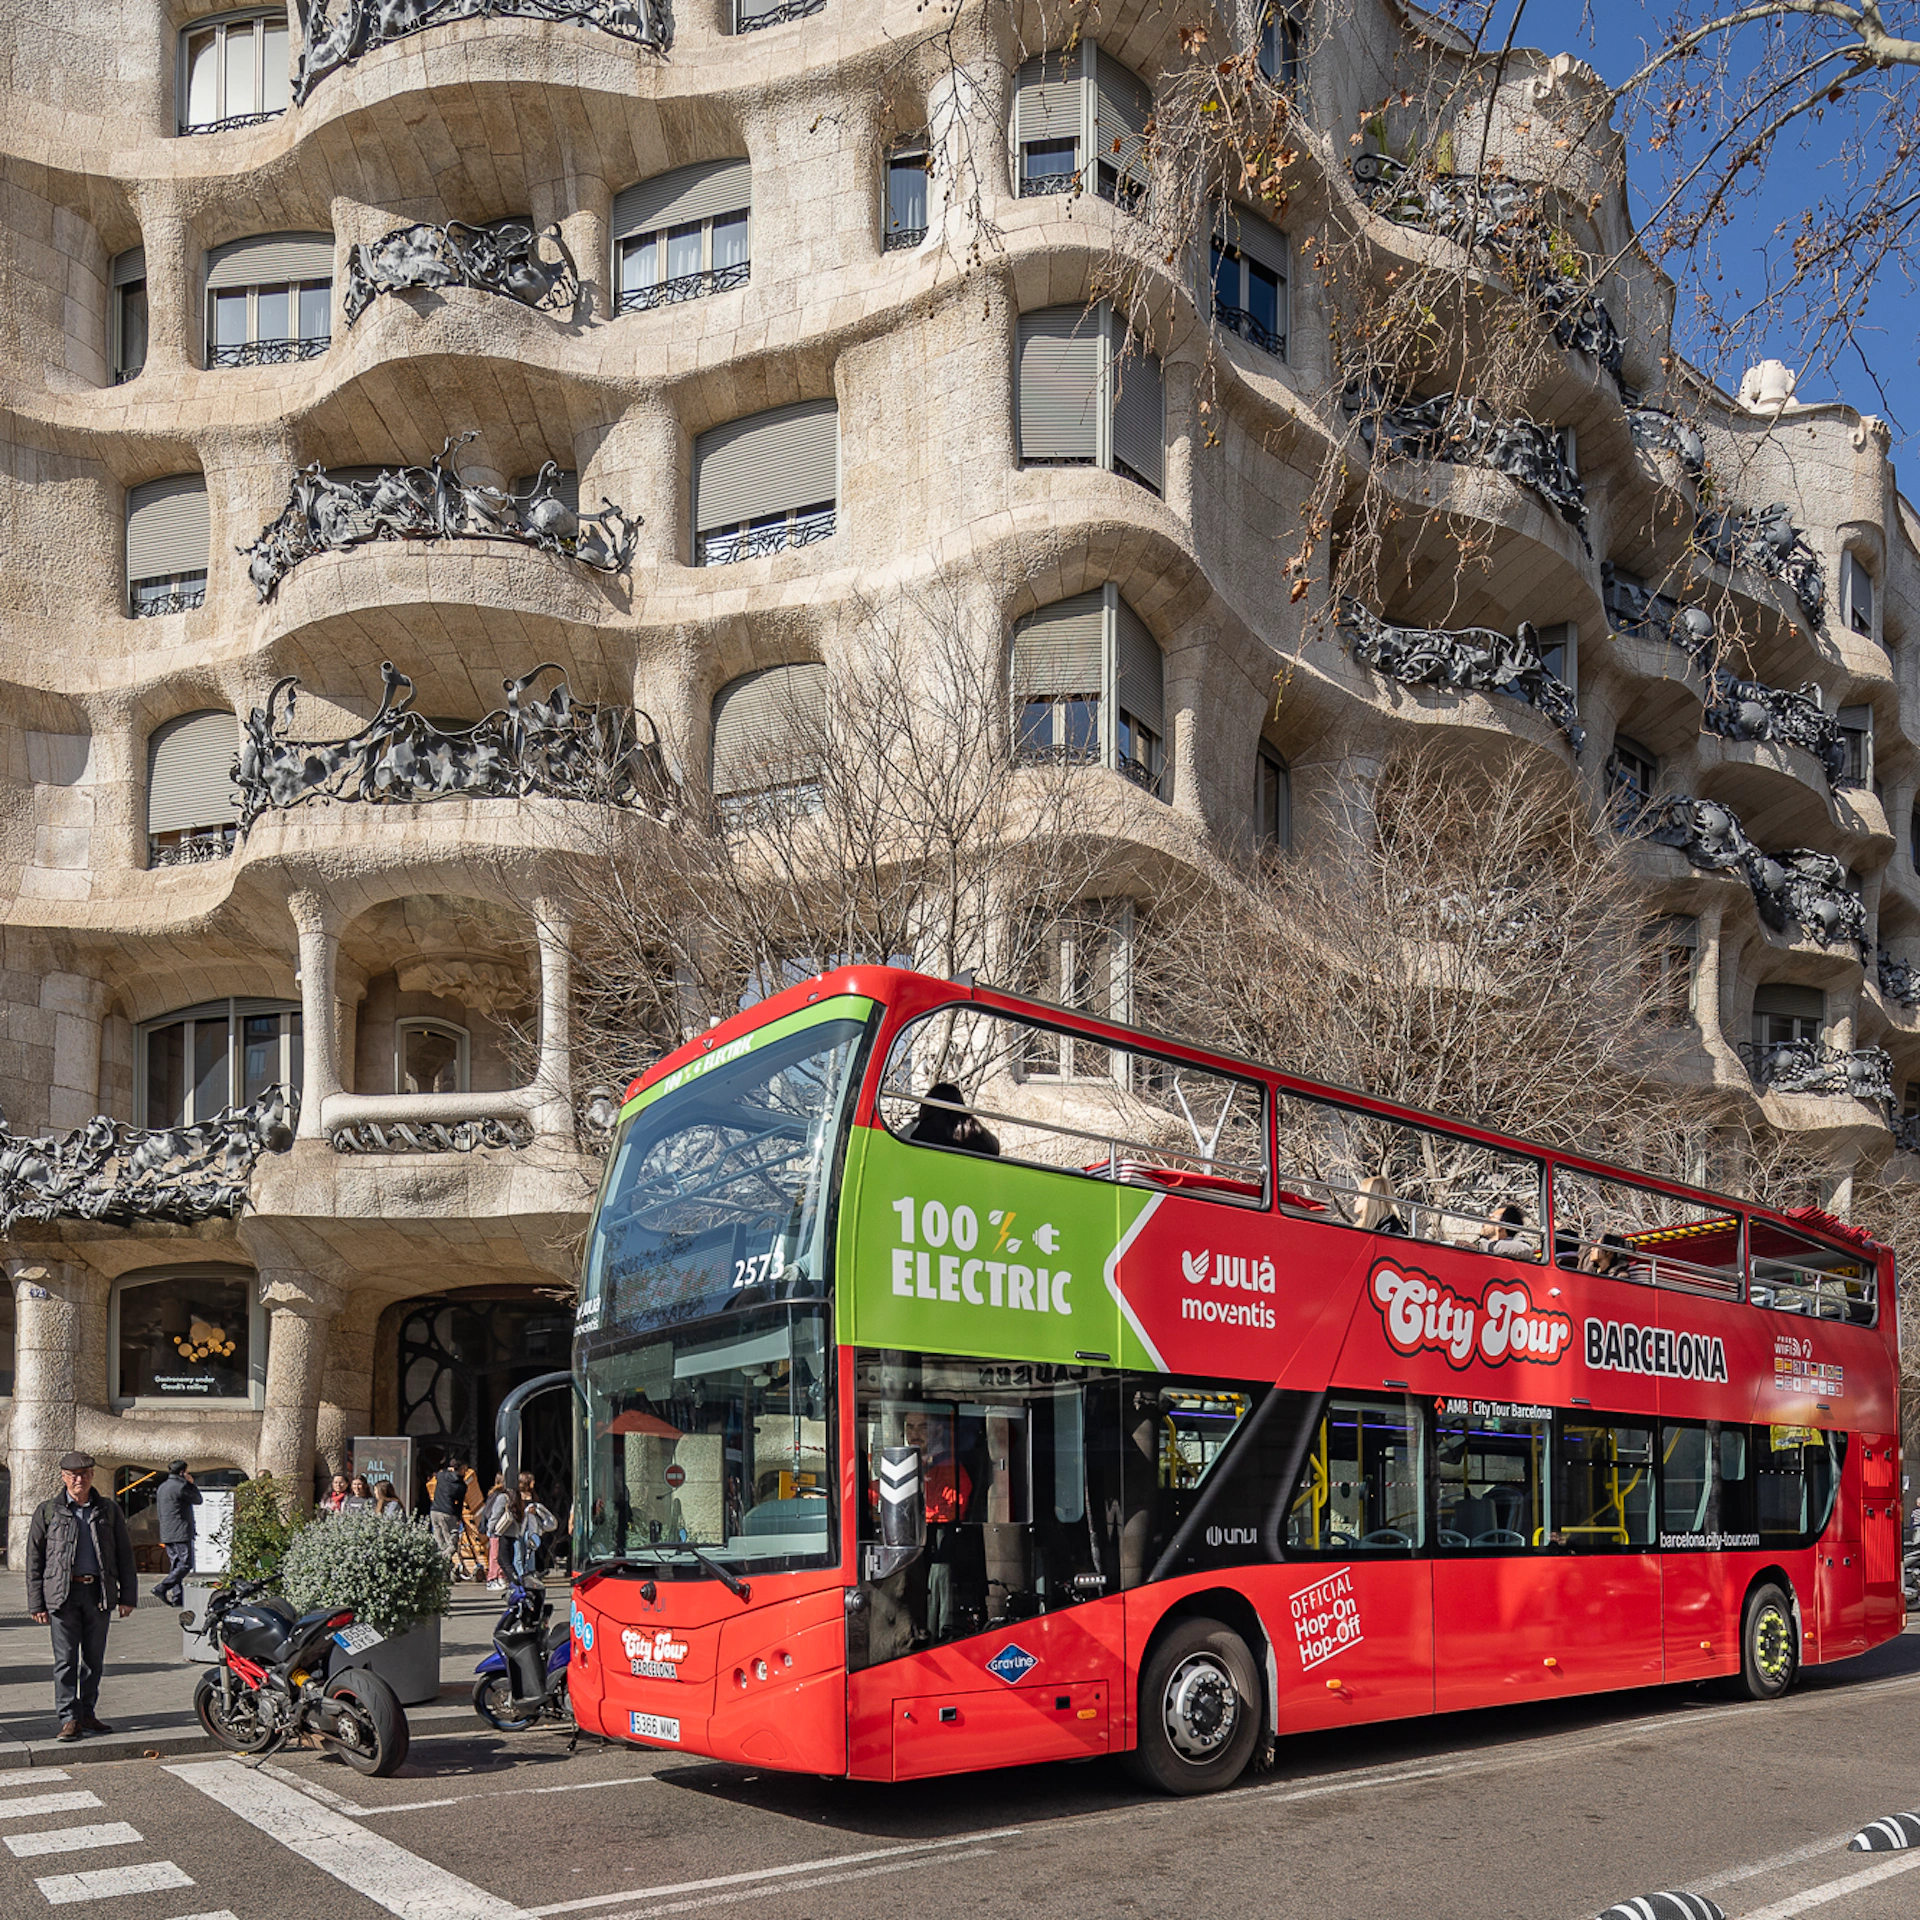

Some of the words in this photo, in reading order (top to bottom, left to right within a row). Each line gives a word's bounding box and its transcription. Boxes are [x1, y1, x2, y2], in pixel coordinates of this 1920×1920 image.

[892, 1196, 979, 1252] 100
[732, 1252, 785, 1289] 2573
[892, 1248, 1072, 1316] ELECTRIC
[1181, 1297, 1276, 1330] moventis
[1374, 1269, 1474, 1360] City
[1481, 1289, 1568, 1357] Tour
[1584, 1317, 1729, 1384] BARCELONA
[187, 1383, 208, 1392] ceiling
[195, 1375, 215, 1383] under
[1447, 1399, 1468, 1414] AMB
[1473, 1401, 1490, 1418] City
[1491, 1402, 1510, 1416] Tour
[1511, 1403, 1552, 1420] Barcelona
[367, 1460, 385, 1471] ALL
[1660, 1531, 1760, 1551] barcelona.city-tour.com
[1291, 1574, 1353, 1618] OFFICIAL
[1294, 1598, 1356, 1642] Hop-On
[621, 1629, 652, 1662] City
[654, 1632, 688, 1661] Tour
[1299, 1614, 1360, 1665] Hop-Off
[632, 1659, 677, 1679] BARCELONA
[636, 1714, 658, 1735] 5366
[660, 1720, 678, 1739] MMC
